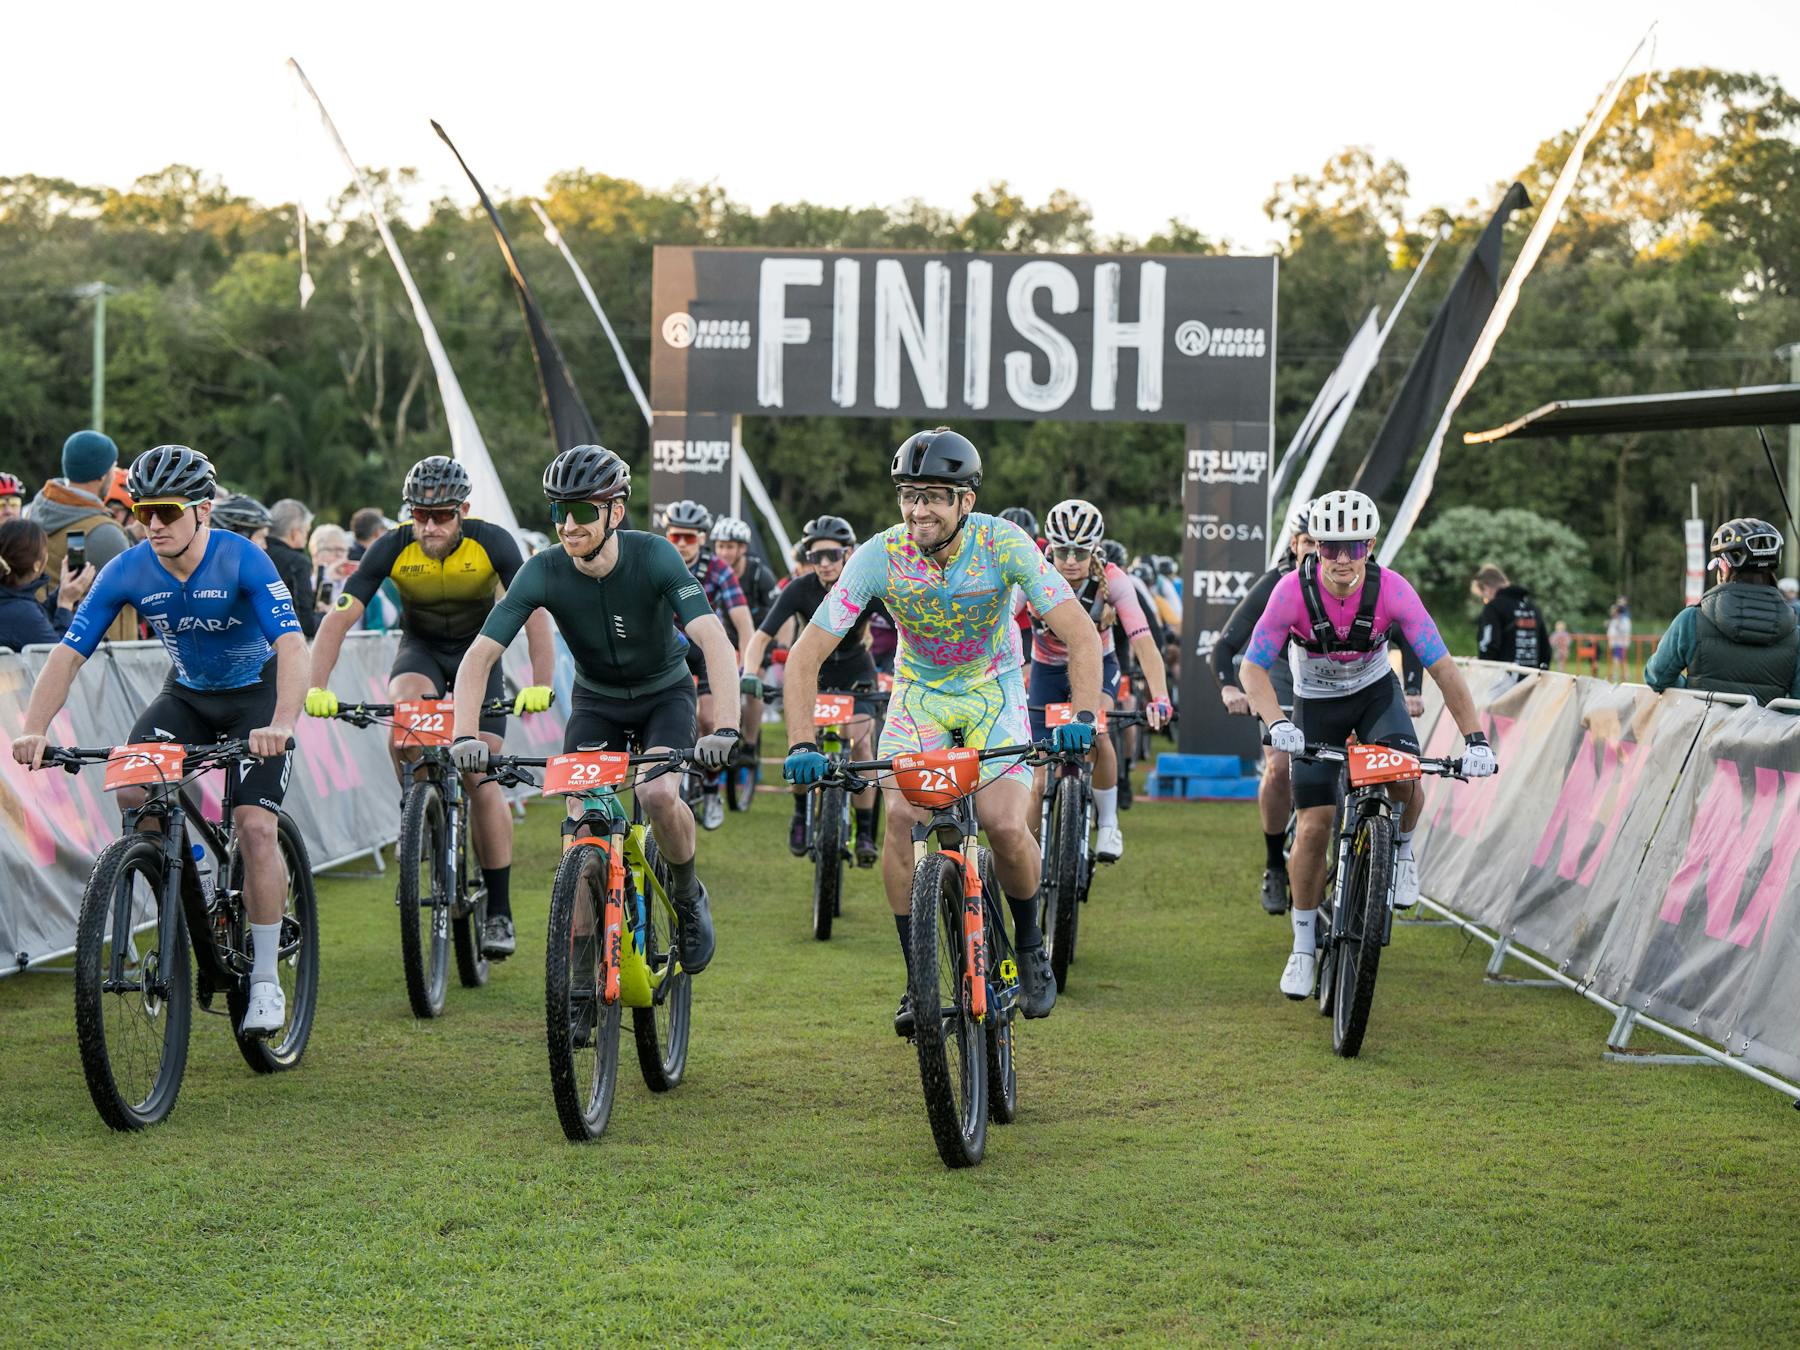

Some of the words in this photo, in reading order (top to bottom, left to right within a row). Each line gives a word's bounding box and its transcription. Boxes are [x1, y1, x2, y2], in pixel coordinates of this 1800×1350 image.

[757, 258, 1167, 412] FINISH
[1186, 524, 1264, 541] NOOSA
[1193, 570, 1255, 598] FIXX
[613, 615, 627, 638] MAAP
[410, 713, 444, 731] 222
[1365, 752, 1403, 770] 220
[570, 763, 601, 780] 29
[918, 766, 957, 792] 221
